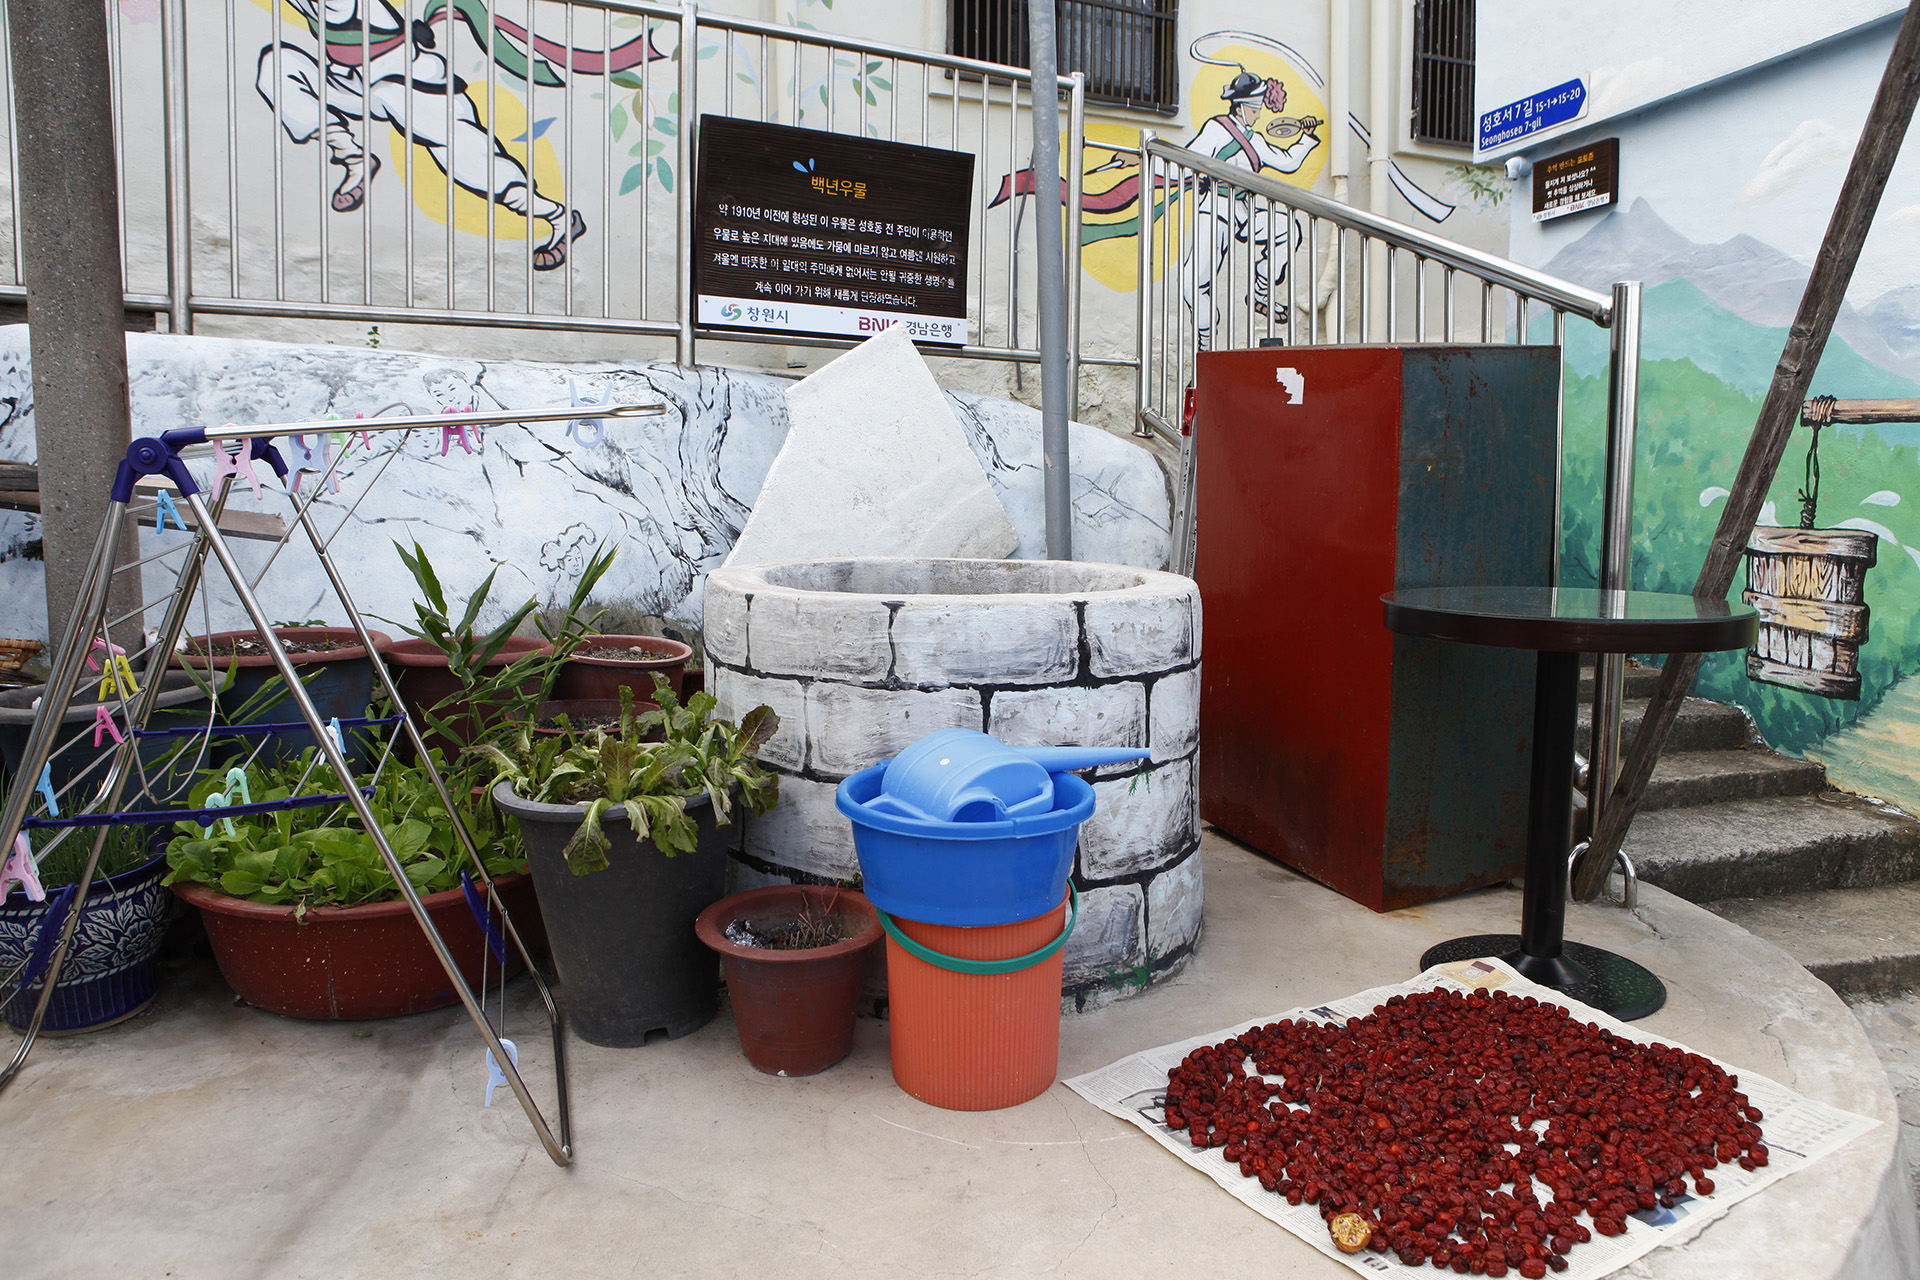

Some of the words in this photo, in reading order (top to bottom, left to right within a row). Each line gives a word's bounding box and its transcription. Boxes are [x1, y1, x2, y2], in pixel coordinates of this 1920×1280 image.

[1536, 102, 1551, 113] 15-1
[1559, 87, 1581, 105] 15-20
[1482, 124, 1522, 148] Seonghoseo
[1525, 117, 1542, 132] 7-gil
[811, 176, 867, 200] 백년우물
[1581, 189, 1596, 199] 보세요
[718, 203, 728, 217] 약
[731, 206, 761, 220] 1910년
[764, 208, 790, 223] 이전에
[792, 211, 818, 226] 형성된
[820, 216, 829, 228] 이
[831, 216, 855, 230] 우물은
[858, 220, 882, 235] 성호동
[885, 223, 894, 235] 전
[897, 224, 919, 238] 주민이
[922, 228, 953, 242] 이용하던
[713, 227, 739, 242] 우물로
[742, 231, 760, 245] 높은
[763, 233, 788, 247] 지대에
[791, 236, 825, 251] 있음에도
[827, 240, 852, 254] 가뭄에
[854, 243, 879, 257] 마르지
[881, 247, 897, 259] 않고
[900, 249, 923, 262] 여름엔
[925, 251, 956, 265] 시원하고
[713, 252, 739, 267] 겨울엔
[742, 256, 768, 270] 따뜻한
[770, 258, 779, 271] 이
[782, 259, 807, 273] 일대의
[810, 262, 843, 277] 주민에게
[845, 266, 877, 280] 없어서는
[899, 272, 922, 285] 귀중한
[925, 275, 955, 289] 생명수를
[755, 281, 772, 294] 계속
[775, 283, 792, 296] 이어
[795, 285, 812, 297] 가기
[815, 286, 831, 299] 위해
[747, 307, 789, 324] 창원시
[906, 321, 953, 338] 경남은행
